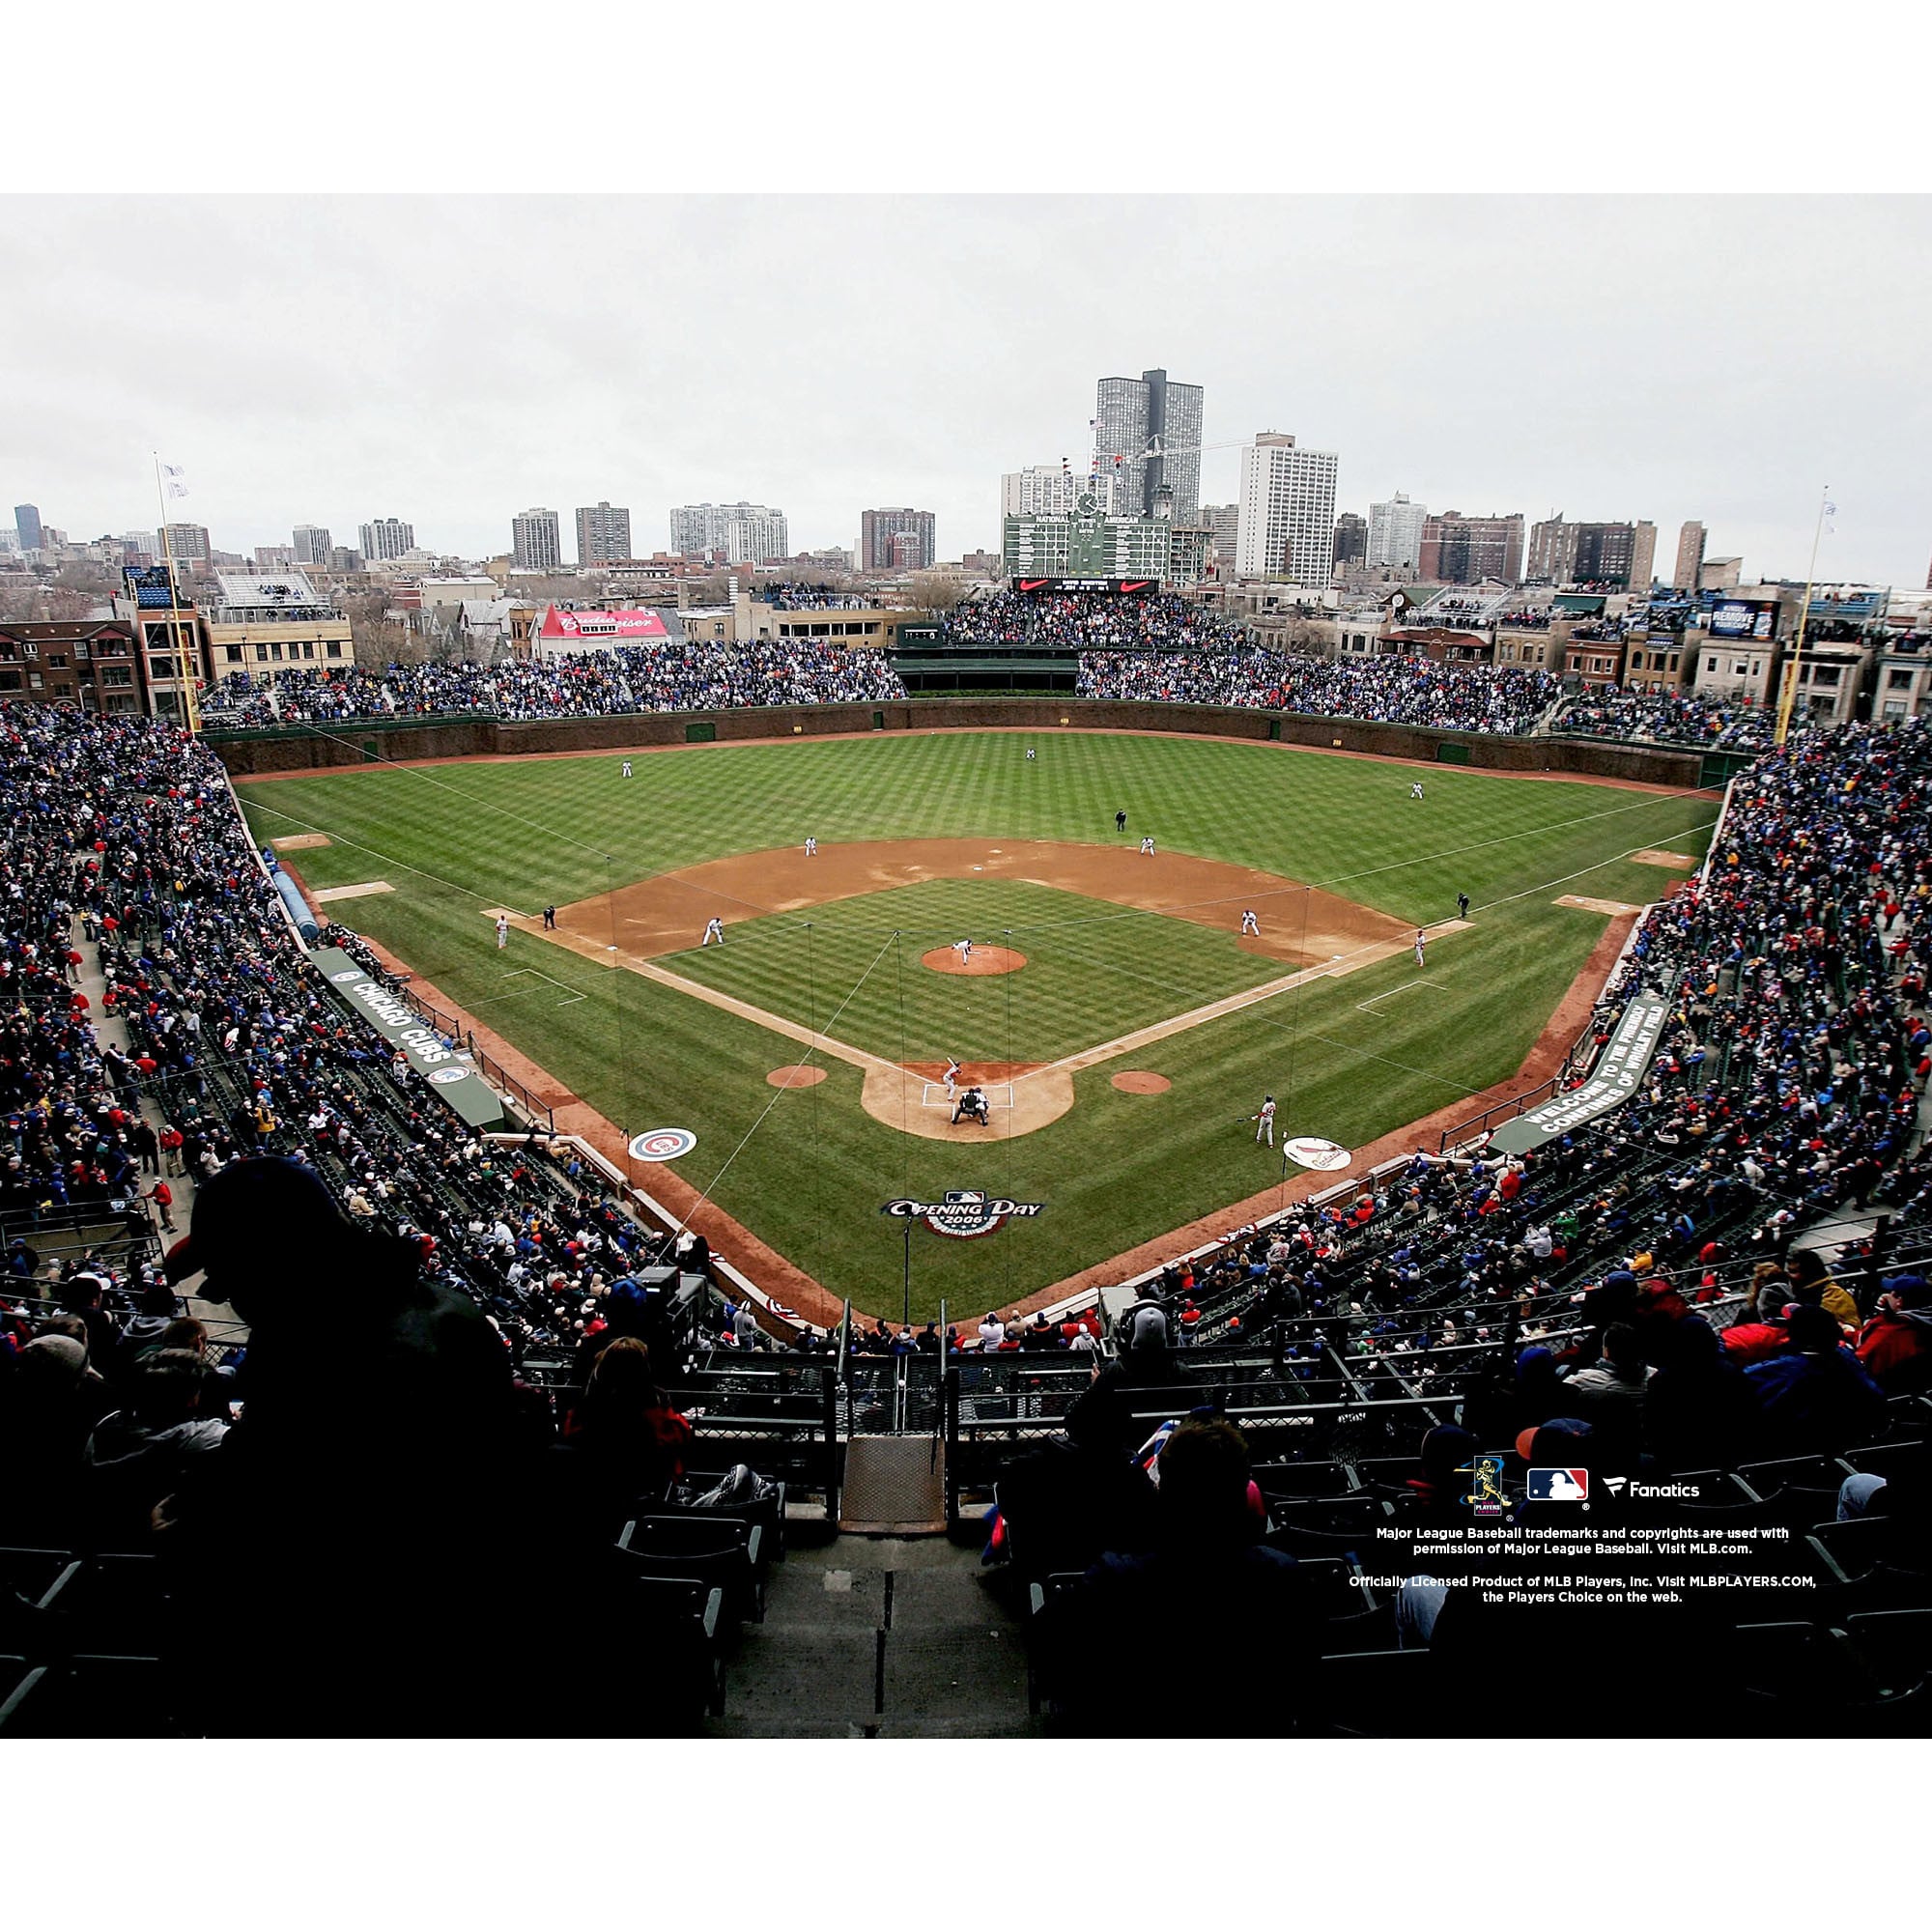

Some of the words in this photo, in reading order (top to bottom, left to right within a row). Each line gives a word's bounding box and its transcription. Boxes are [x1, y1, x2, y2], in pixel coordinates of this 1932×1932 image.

[559, 617, 653, 631] Budweiser
[1713, 611, 1755, 624] REMOVE
[353, 982, 413, 1028] CHICAGO
[400, 1029, 451, 1064] CUBS
[1618, 1005, 1647, 1044] FRIENDLY
[1644, 1005, 1664, 1033] FIELD
[1607, 1044, 1629, 1063] THE
[1625, 1029, 1654, 1070] WRIGLEY
[1600, 1065, 1619, 1078] TO
[1617, 1071, 1635, 1088] OF
[1524, 1080, 1610, 1124] WELCOME
[1541, 1088, 1626, 1133] CONFINES
[986, 1199, 1042, 1216] DAY
[944, 1215, 983, 1224] 2006
